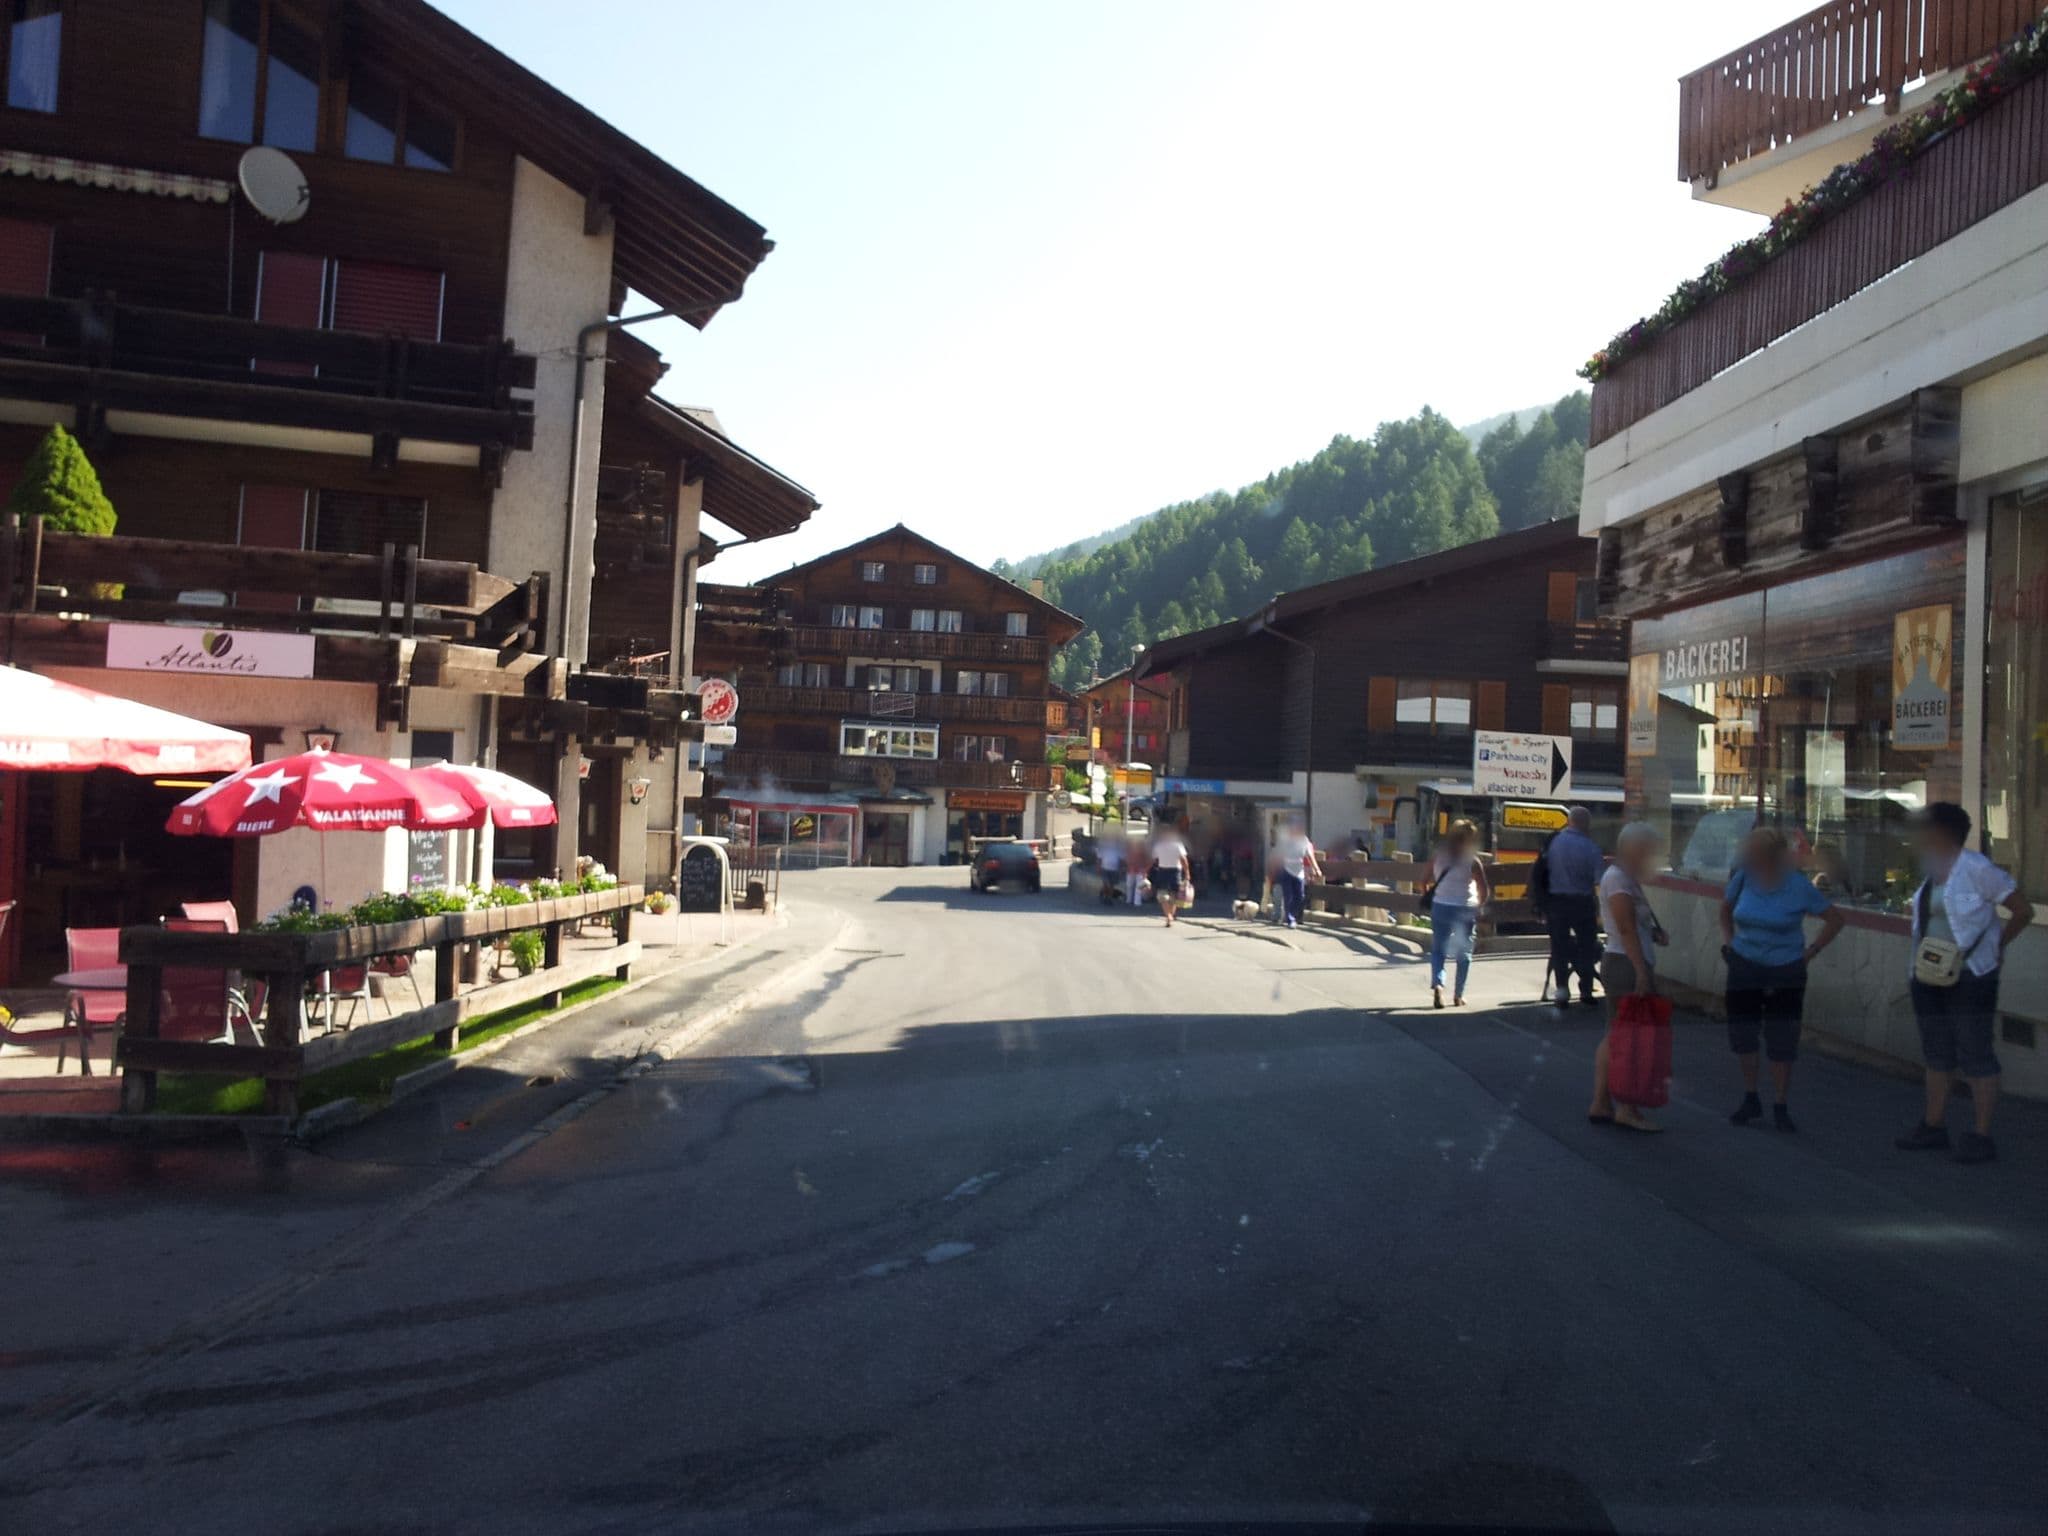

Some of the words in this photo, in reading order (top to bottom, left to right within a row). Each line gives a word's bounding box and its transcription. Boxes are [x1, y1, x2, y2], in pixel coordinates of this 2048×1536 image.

[146, 644, 259, 673] Atlantis
[1665, 636, 1748, 681] BÄCKEREI
[1896, 699, 1947, 719] BÄCKEREI
[1490, 750, 1530, 763] Parkhaus
[1531, 753, 1548, 766] City
[1520, 784, 1537, 796] bar
[312, 808, 406, 824] VALAISANNE
